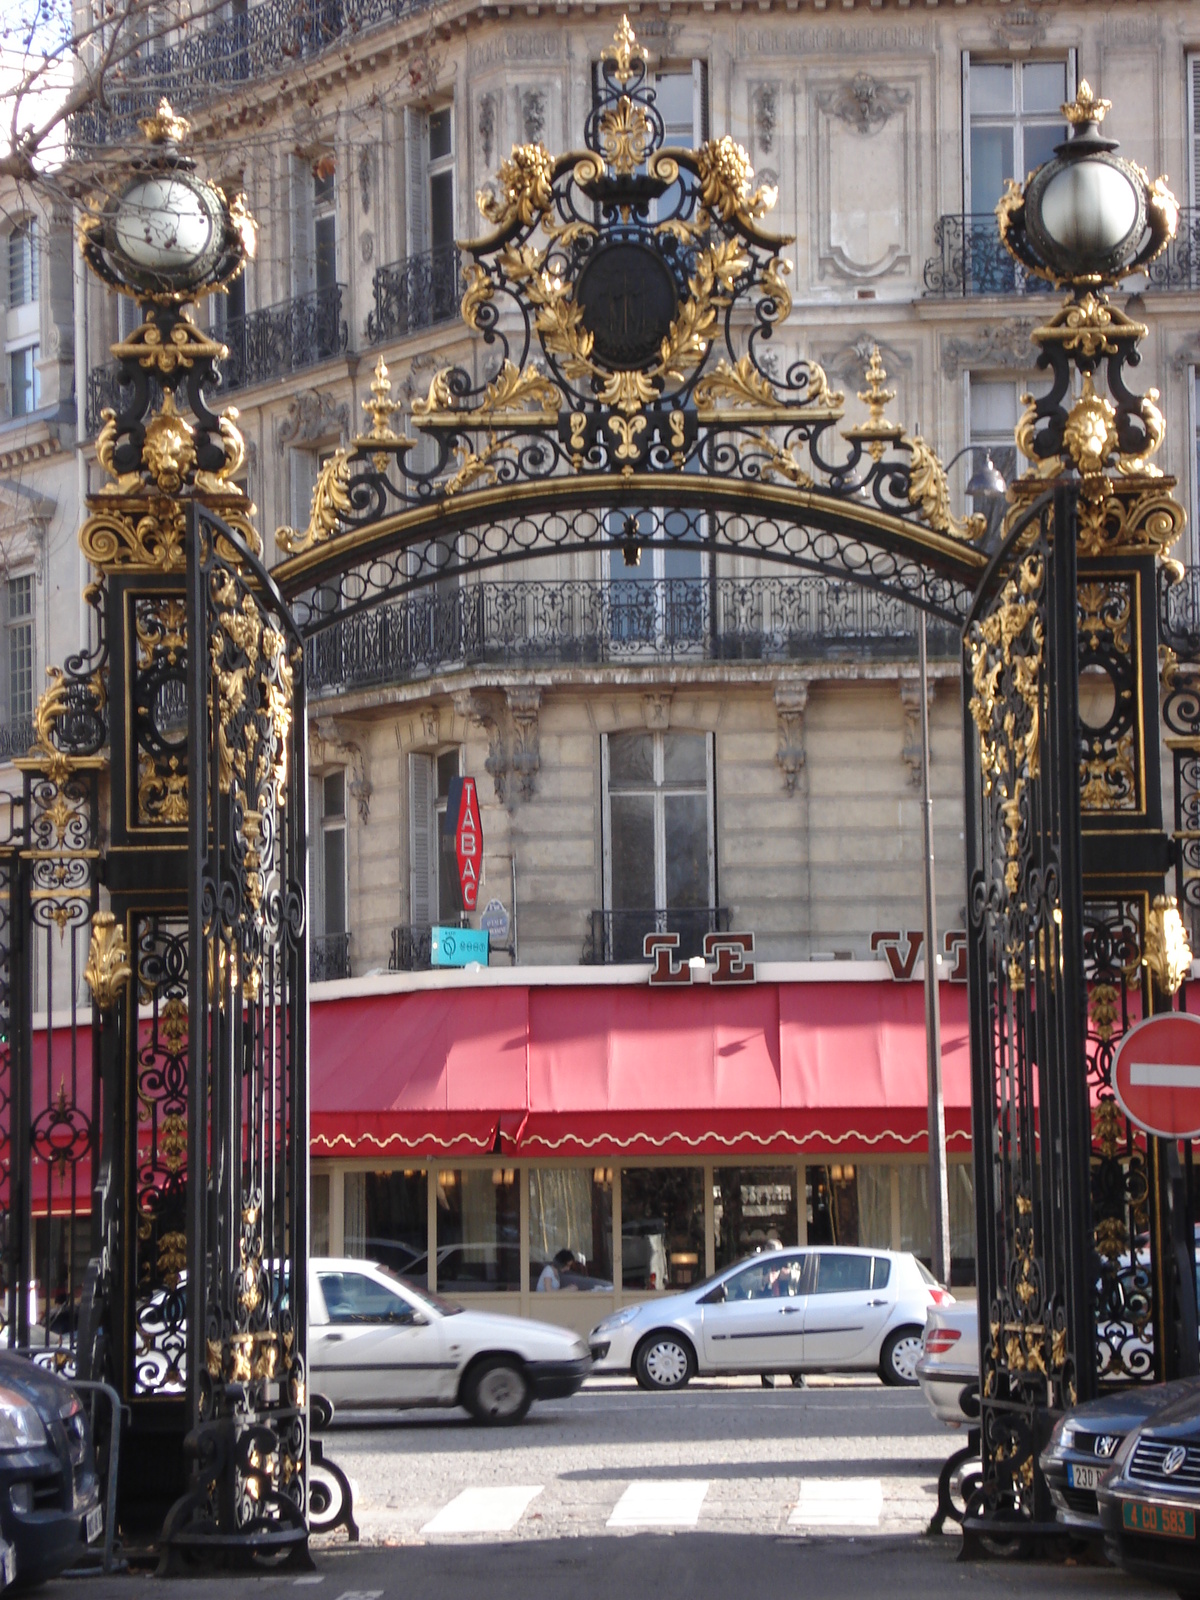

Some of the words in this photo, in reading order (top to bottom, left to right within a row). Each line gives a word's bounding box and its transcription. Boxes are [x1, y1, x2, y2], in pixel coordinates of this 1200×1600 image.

[461, 783, 477, 905] TABAC
[643, 931, 757, 986] LE
[1076, 1467, 1094, 1487] 230
[1130, 1504, 1138, 1526] 4
[1162, 1507, 1186, 1534] 583
